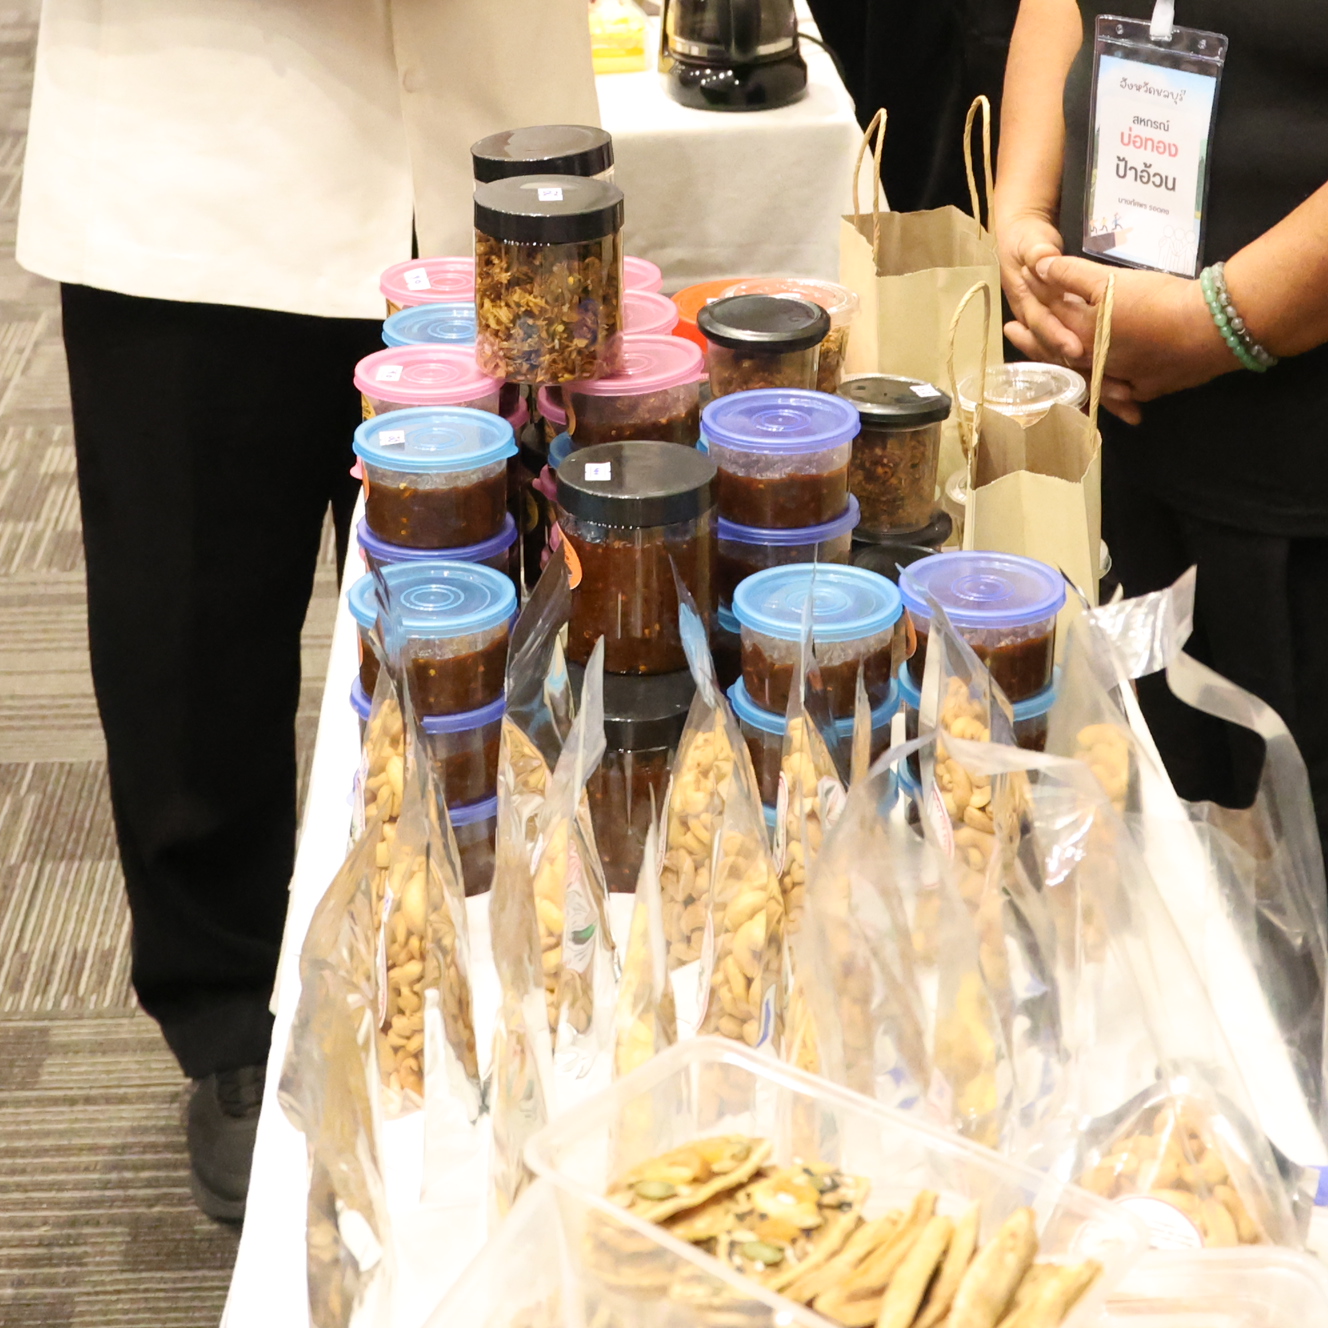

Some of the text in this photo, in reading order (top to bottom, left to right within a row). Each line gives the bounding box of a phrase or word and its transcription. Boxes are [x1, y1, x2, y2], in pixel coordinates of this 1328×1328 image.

[1120, 77, 1186, 105] จังหวัดชลบุรี
[1133, 115, 1170, 132] สหกรณ์
[1120, 127, 1179, 158] บ่อทอง
[1115, 155, 1176, 192] ป้าอ้วน
